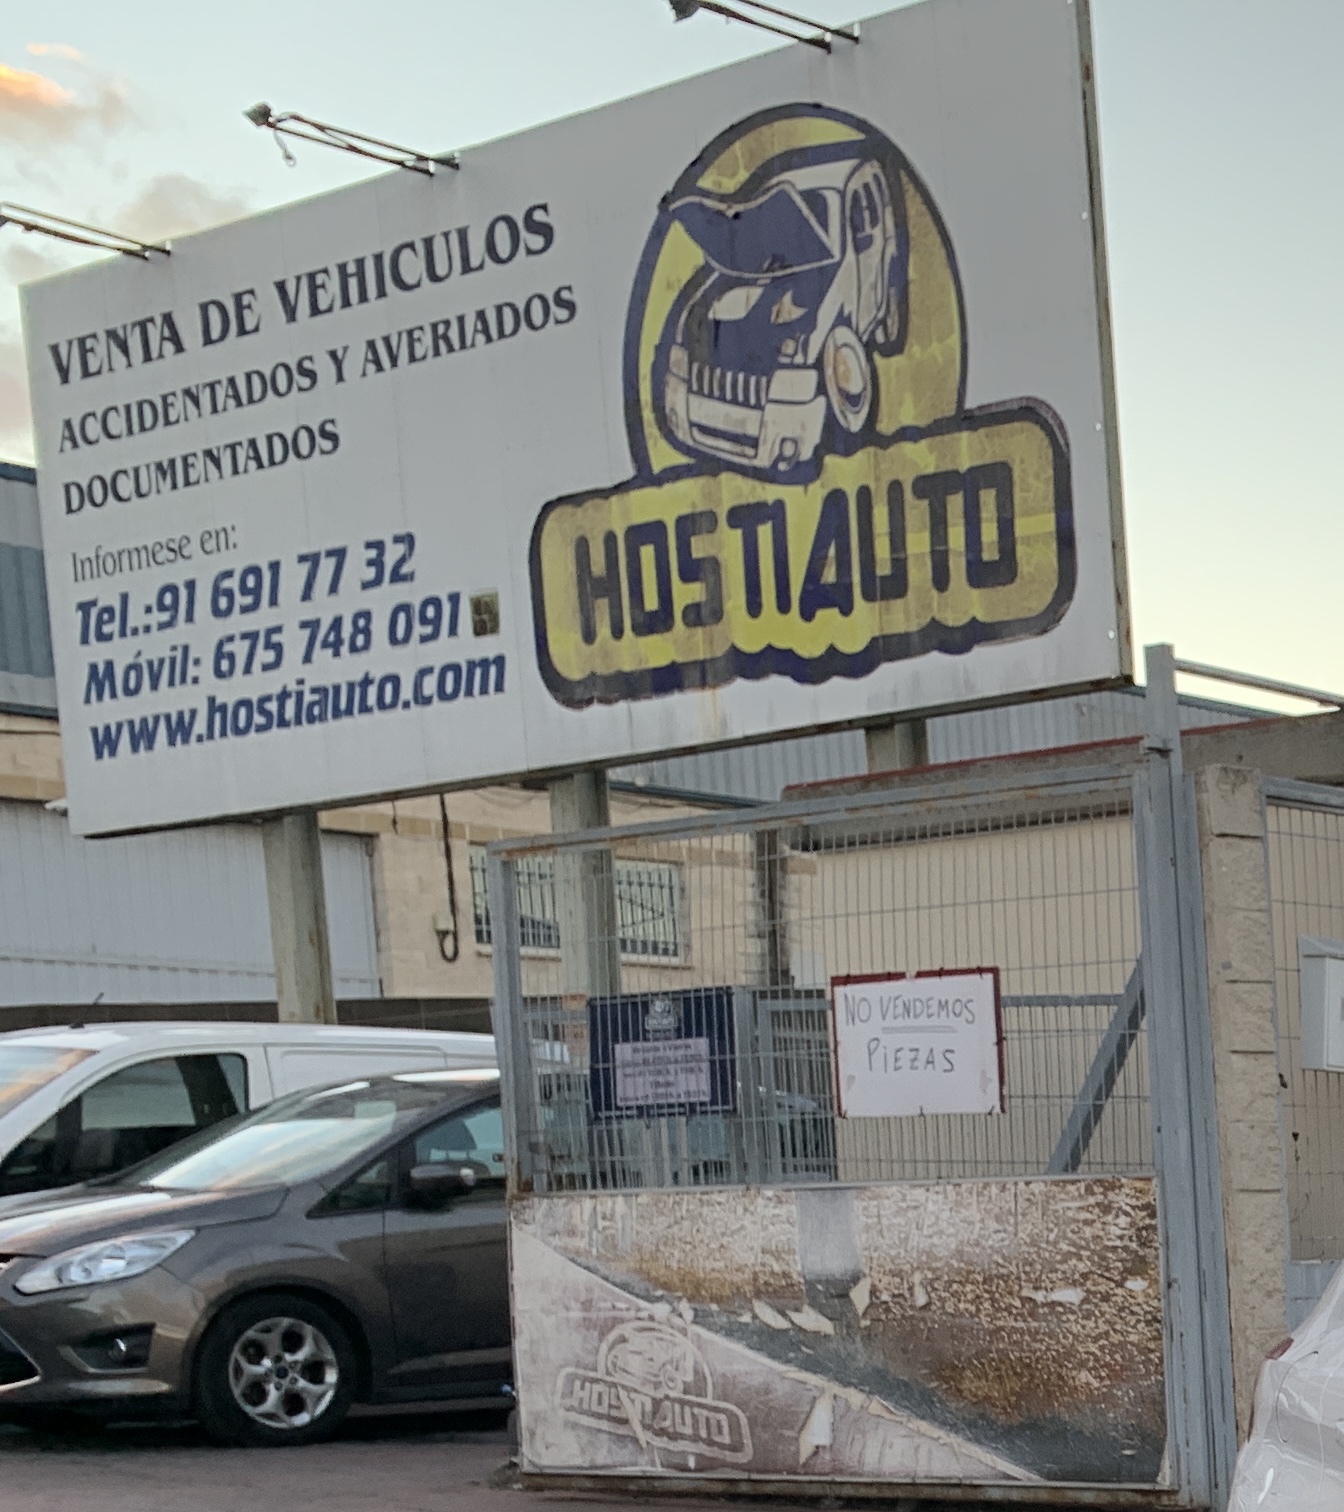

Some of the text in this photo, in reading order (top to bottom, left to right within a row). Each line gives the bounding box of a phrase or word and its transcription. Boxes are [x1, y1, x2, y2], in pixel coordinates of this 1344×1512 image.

[49, 202, 556, 386] VENTA DE VEHICULOS
[58, 285, 578, 454] ACCIDENTADOS Y AVERIADOS
[63, 418, 341, 516] DOCUMENTADOS
[72, 523, 238, 584] Informese en:
[75, 532, 416, 647] Tel.:91 691 77 32
[575, 460, 1018, 646] HOSTIAUTO
[83, 591, 461, 706] Móvil: 675 748 091
[90, 653, 507, 762] www.hostiauto.com
[843, 993, 976, 1026] NO VENDEMOS
